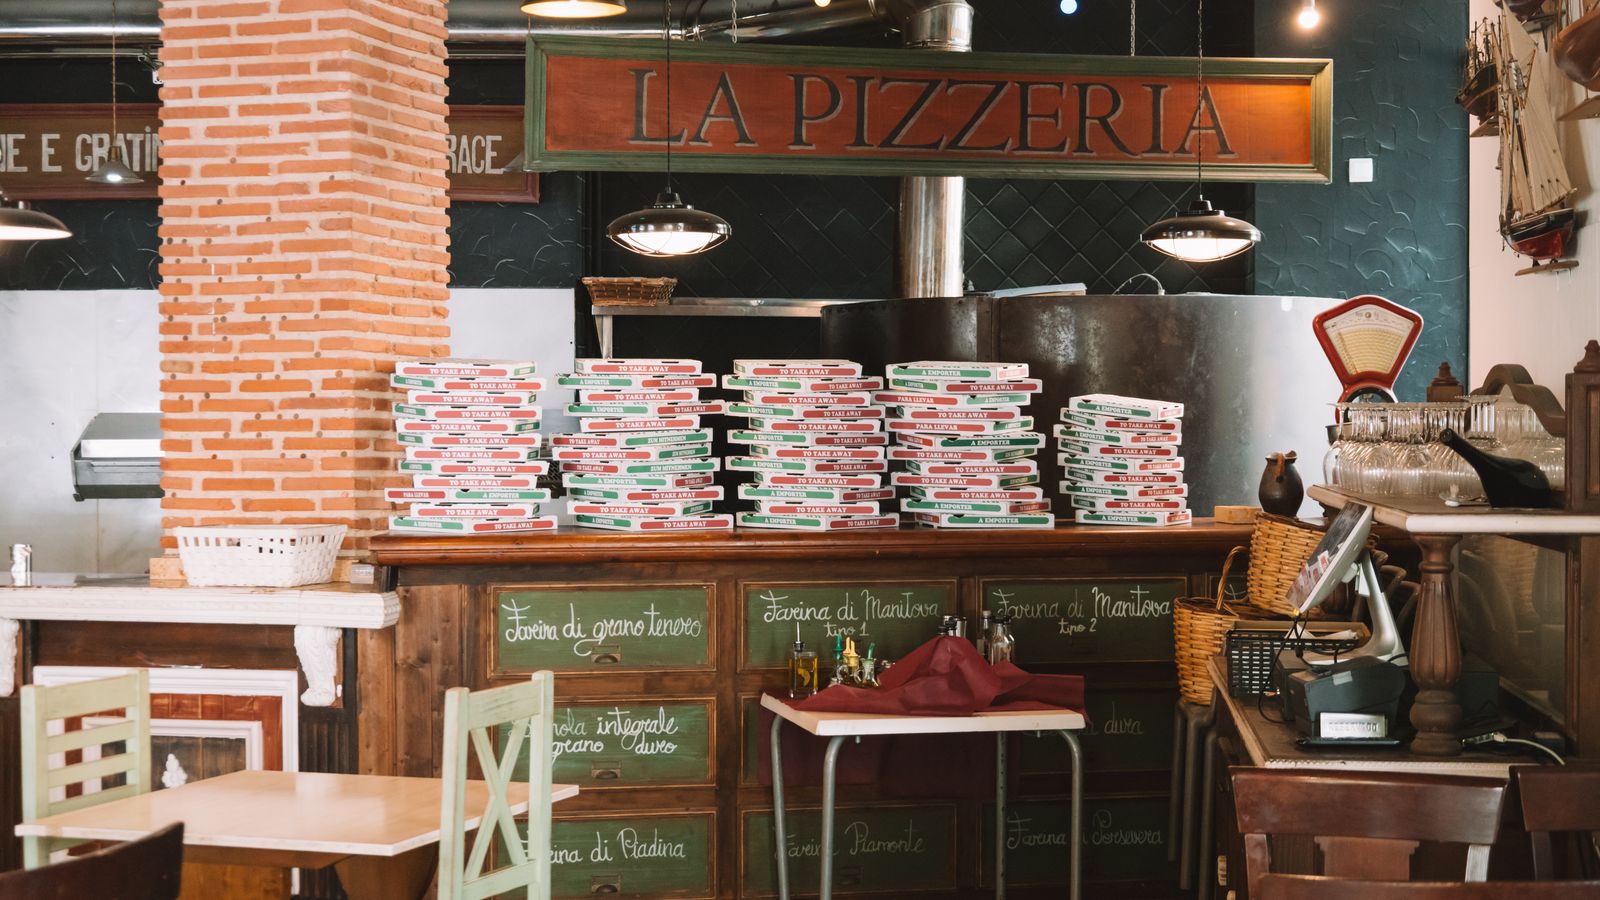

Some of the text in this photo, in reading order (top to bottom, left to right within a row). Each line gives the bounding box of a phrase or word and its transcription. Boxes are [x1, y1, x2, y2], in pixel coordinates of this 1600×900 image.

[628, 68, 1238, 159] LA PIZZERIA
[42, 134, 62, 172] E
[760, 590, 833, 623] Farina
[837, 592, 859, 621] di
[1067, 588, 1084, 618] di
[501, 599, 701, 657] Farina di grano tenero
[859, 621, 870, 637] 1
[1089, 618, 1097, 633] 2
[596, 706, 679, 750] integrale
[634, 732, 678, 755] duro
[590, 831, 613, 862] di
[616, 827, 686, 860] Piadina
